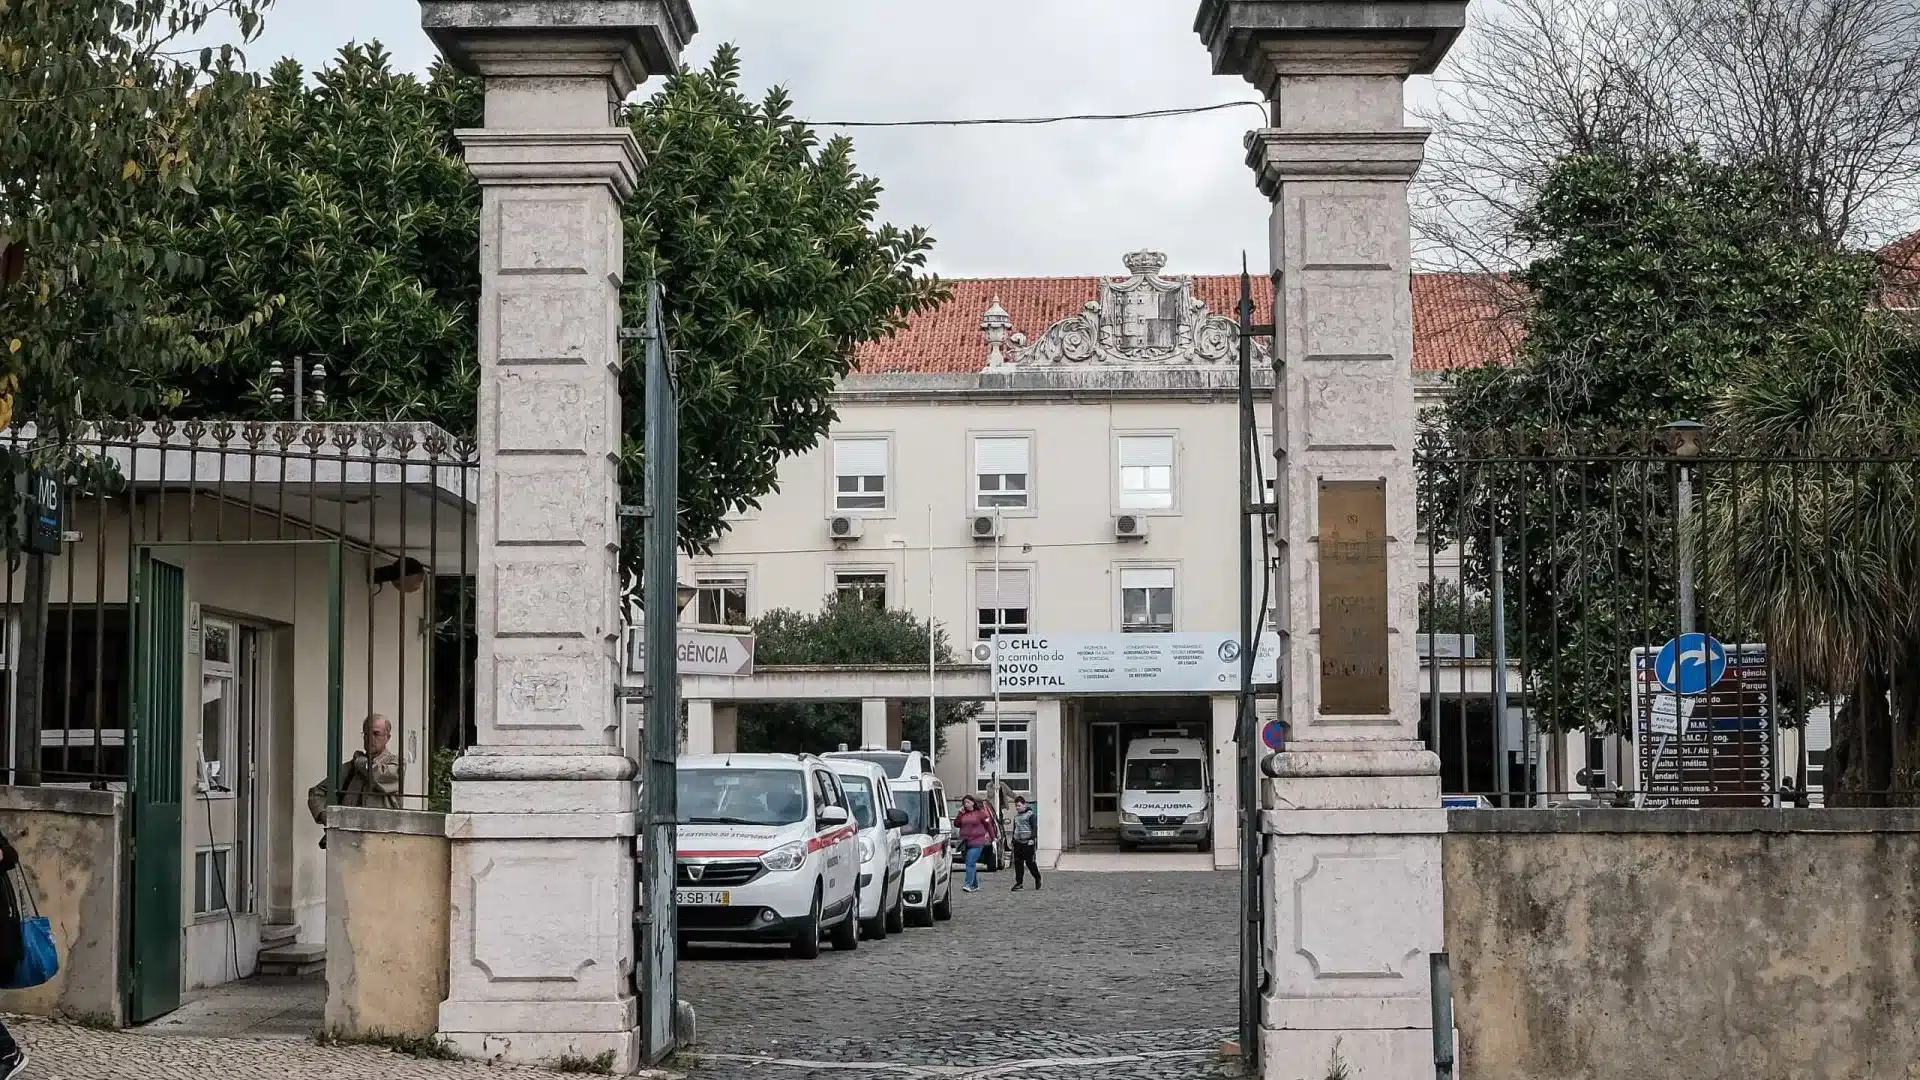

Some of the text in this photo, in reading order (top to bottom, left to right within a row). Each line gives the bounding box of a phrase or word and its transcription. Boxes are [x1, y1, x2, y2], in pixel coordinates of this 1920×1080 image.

[38, 475, 57, 511] MB
[1011, 639, 1048, 649] CHLC
[638, 640, 728, 664] EGÊNCIA
[1008, 651, 1050, 662] caminho
[1728, 656, 1765, 664] Peiátrico
[998, 663, 1038, 674] NOVO
[1733, 668, 1767, 679] Ugência
[998, 676, 1066, 686] HOSPITAL
[1741, 682, 1768, 691] Parque
[1713, 735, 1729, 743] cog.
[1698, 747, 1720, 756] Aleg.
